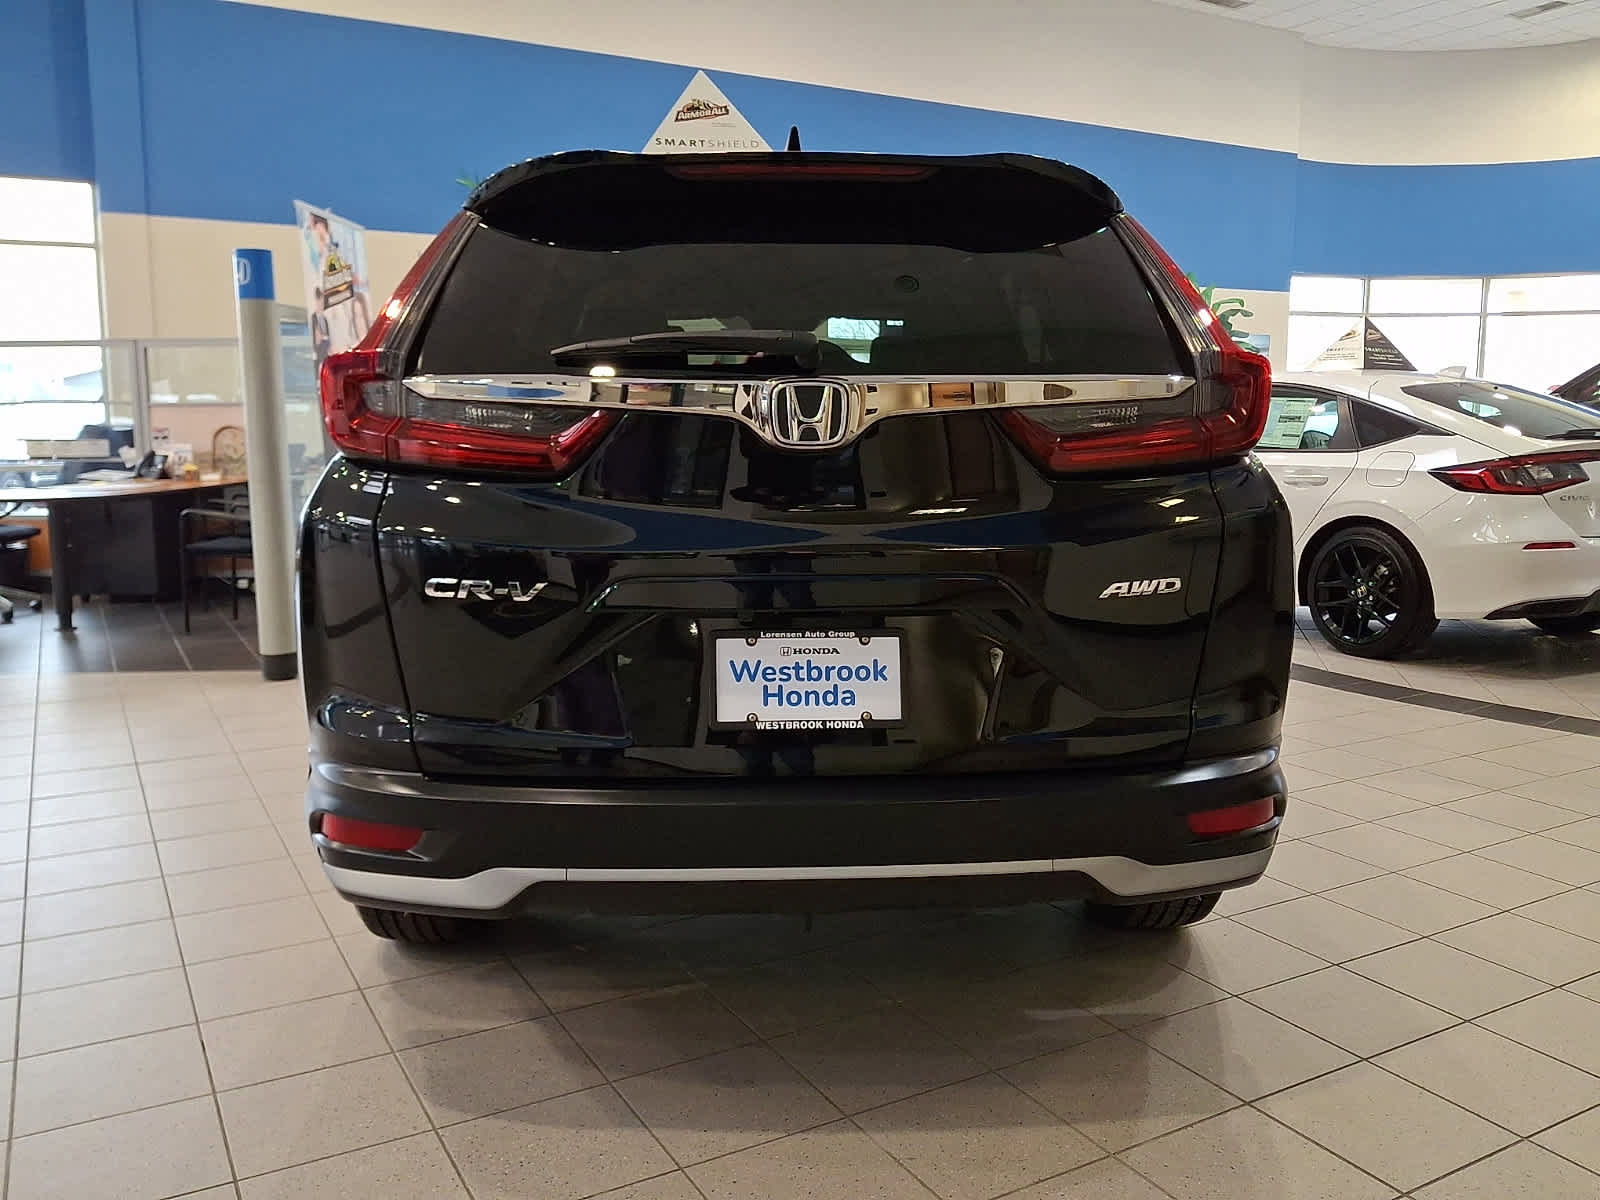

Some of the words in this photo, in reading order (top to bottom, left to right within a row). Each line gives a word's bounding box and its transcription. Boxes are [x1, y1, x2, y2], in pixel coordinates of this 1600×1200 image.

[424, 577, 548, 602] CR-V
[1098, 577, 1182, 599] AWD
[793, 647, 840, 655] HONDA
[729, 659, 888, 683] Westbrook
[762, 684, 856, 707] Honda
[756, 720, 823, 730] WESTBROOK
[826, 720, 864, 729] HONDA
